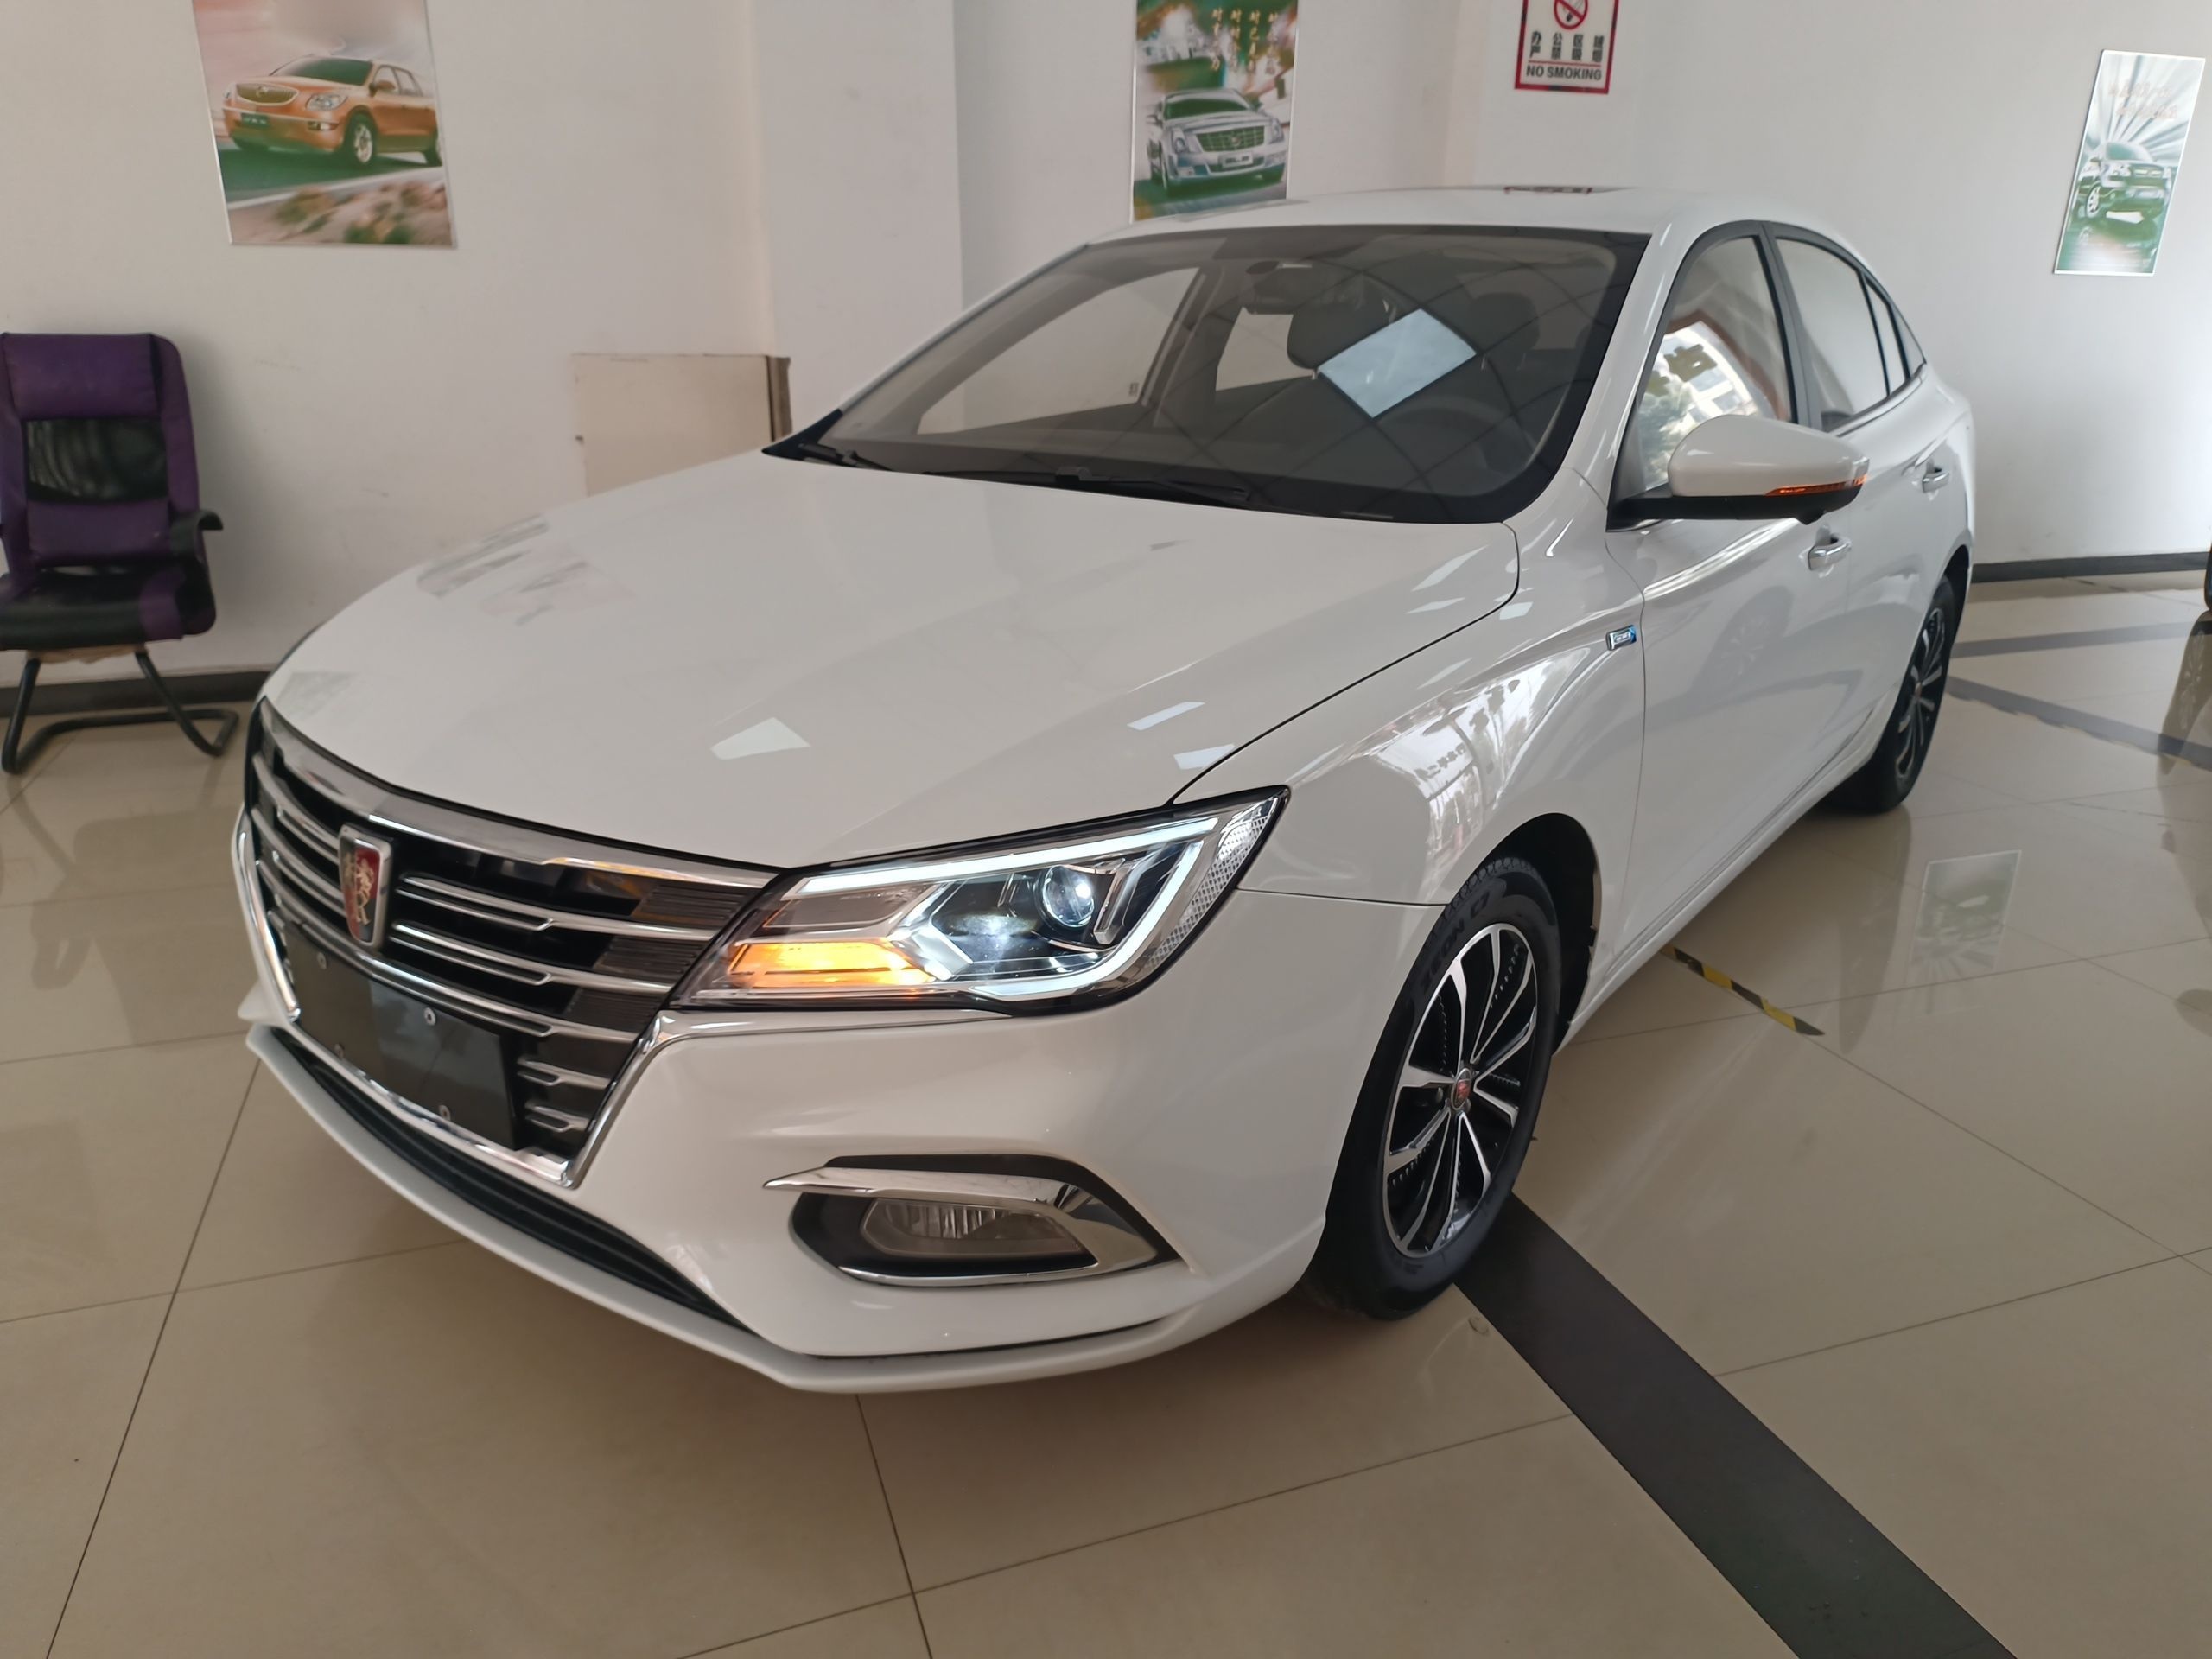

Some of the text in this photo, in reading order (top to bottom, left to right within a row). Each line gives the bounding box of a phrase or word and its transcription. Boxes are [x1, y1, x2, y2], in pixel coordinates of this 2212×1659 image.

[1530, 30, 1605, 48] 办公区域
[1526, 65, 1602, 80] NO SMOKING
